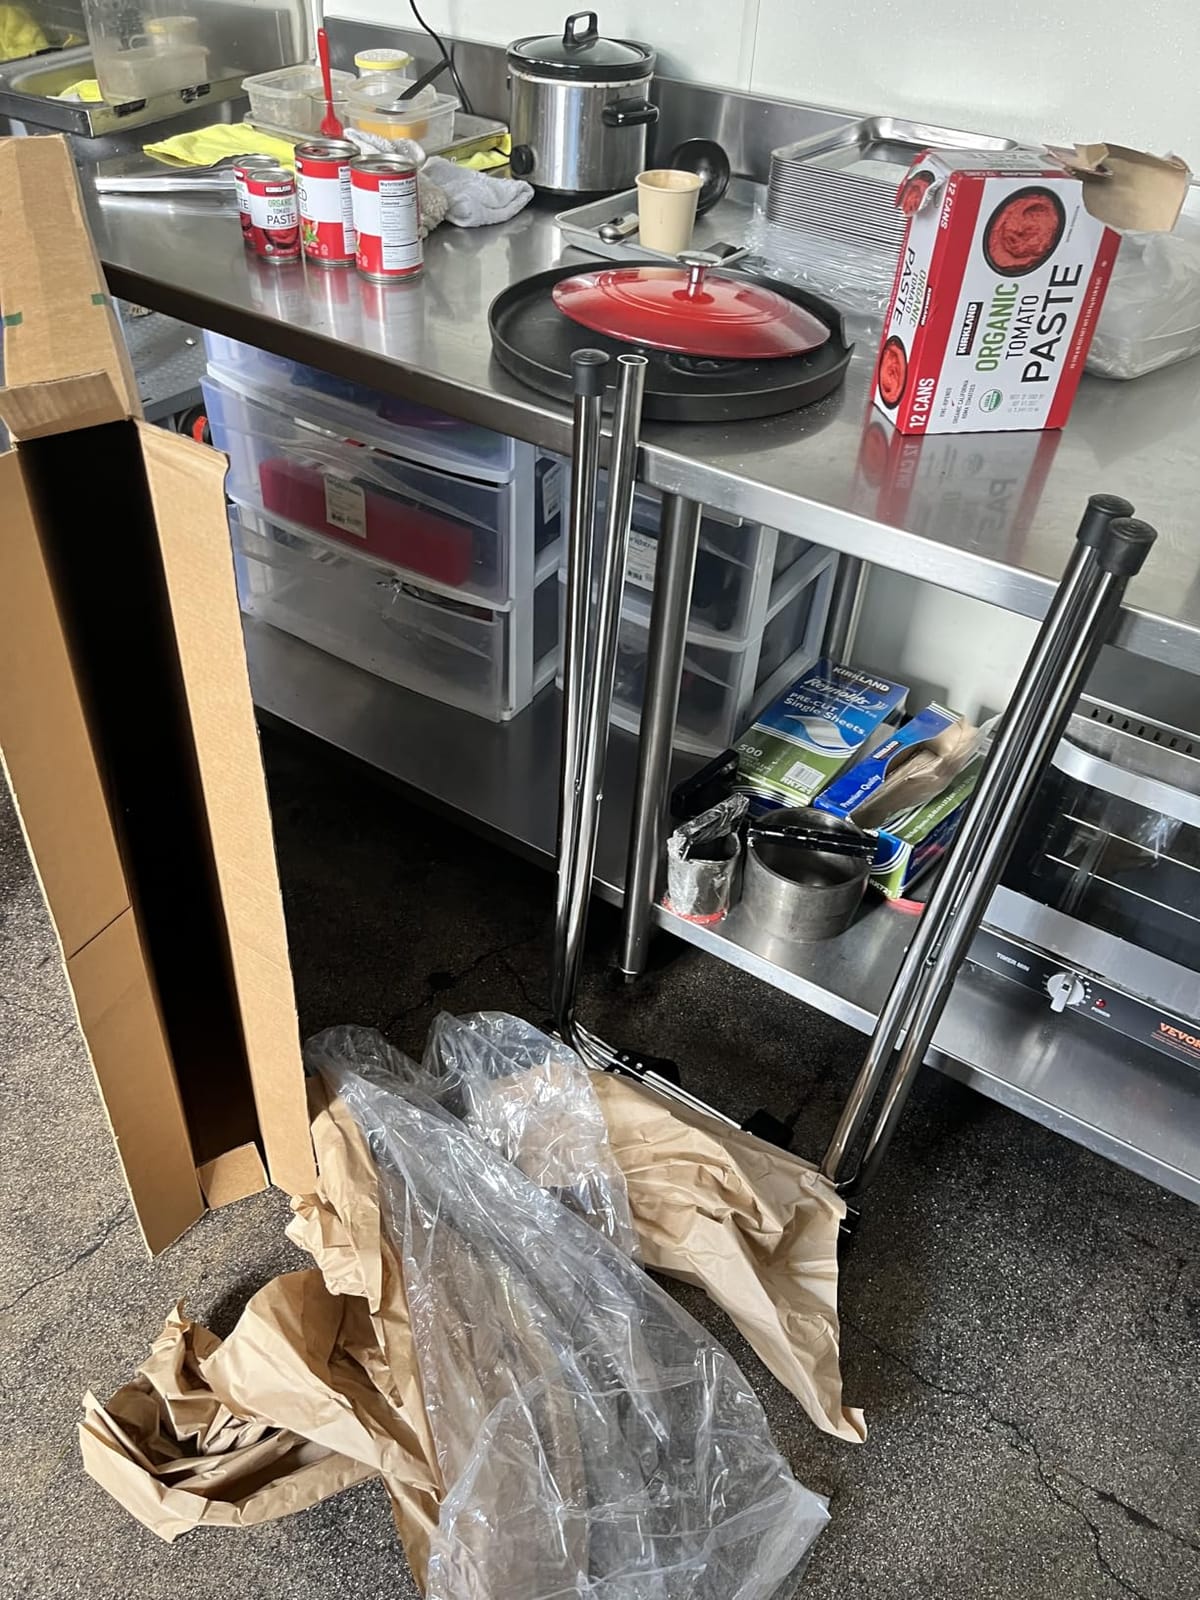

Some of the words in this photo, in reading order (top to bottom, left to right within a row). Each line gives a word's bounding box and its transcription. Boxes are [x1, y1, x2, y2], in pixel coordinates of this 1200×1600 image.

[267, 213, 296, 225] PASTE
[940, 194, 954, 229] CANS
[893, 247, 915, 326] PASTE
[906, 272, 918, 314] TOMATO
[910, 270, 926, 327] ORGANIC
[957, 303, 978, 355] KIRKLAND
[975, 283, 1019, 372] ORGANIC
[1005, 295, 1039, 360] TOMATO
[1021, 264, 1083, 383] PASTE
[914, 378, 935, 413] CANS
[909, 413, 926, 428] 12
[804, 679, 870, 705] Reynolds
[833, 667, 890, 692] KIRKLAND
[784, 698, 821, 714] Single
[790, 692, 838, 712] PRE-CUT
[738, 743, 763, 757] 500
[860, 774, 882, 791] Quality
